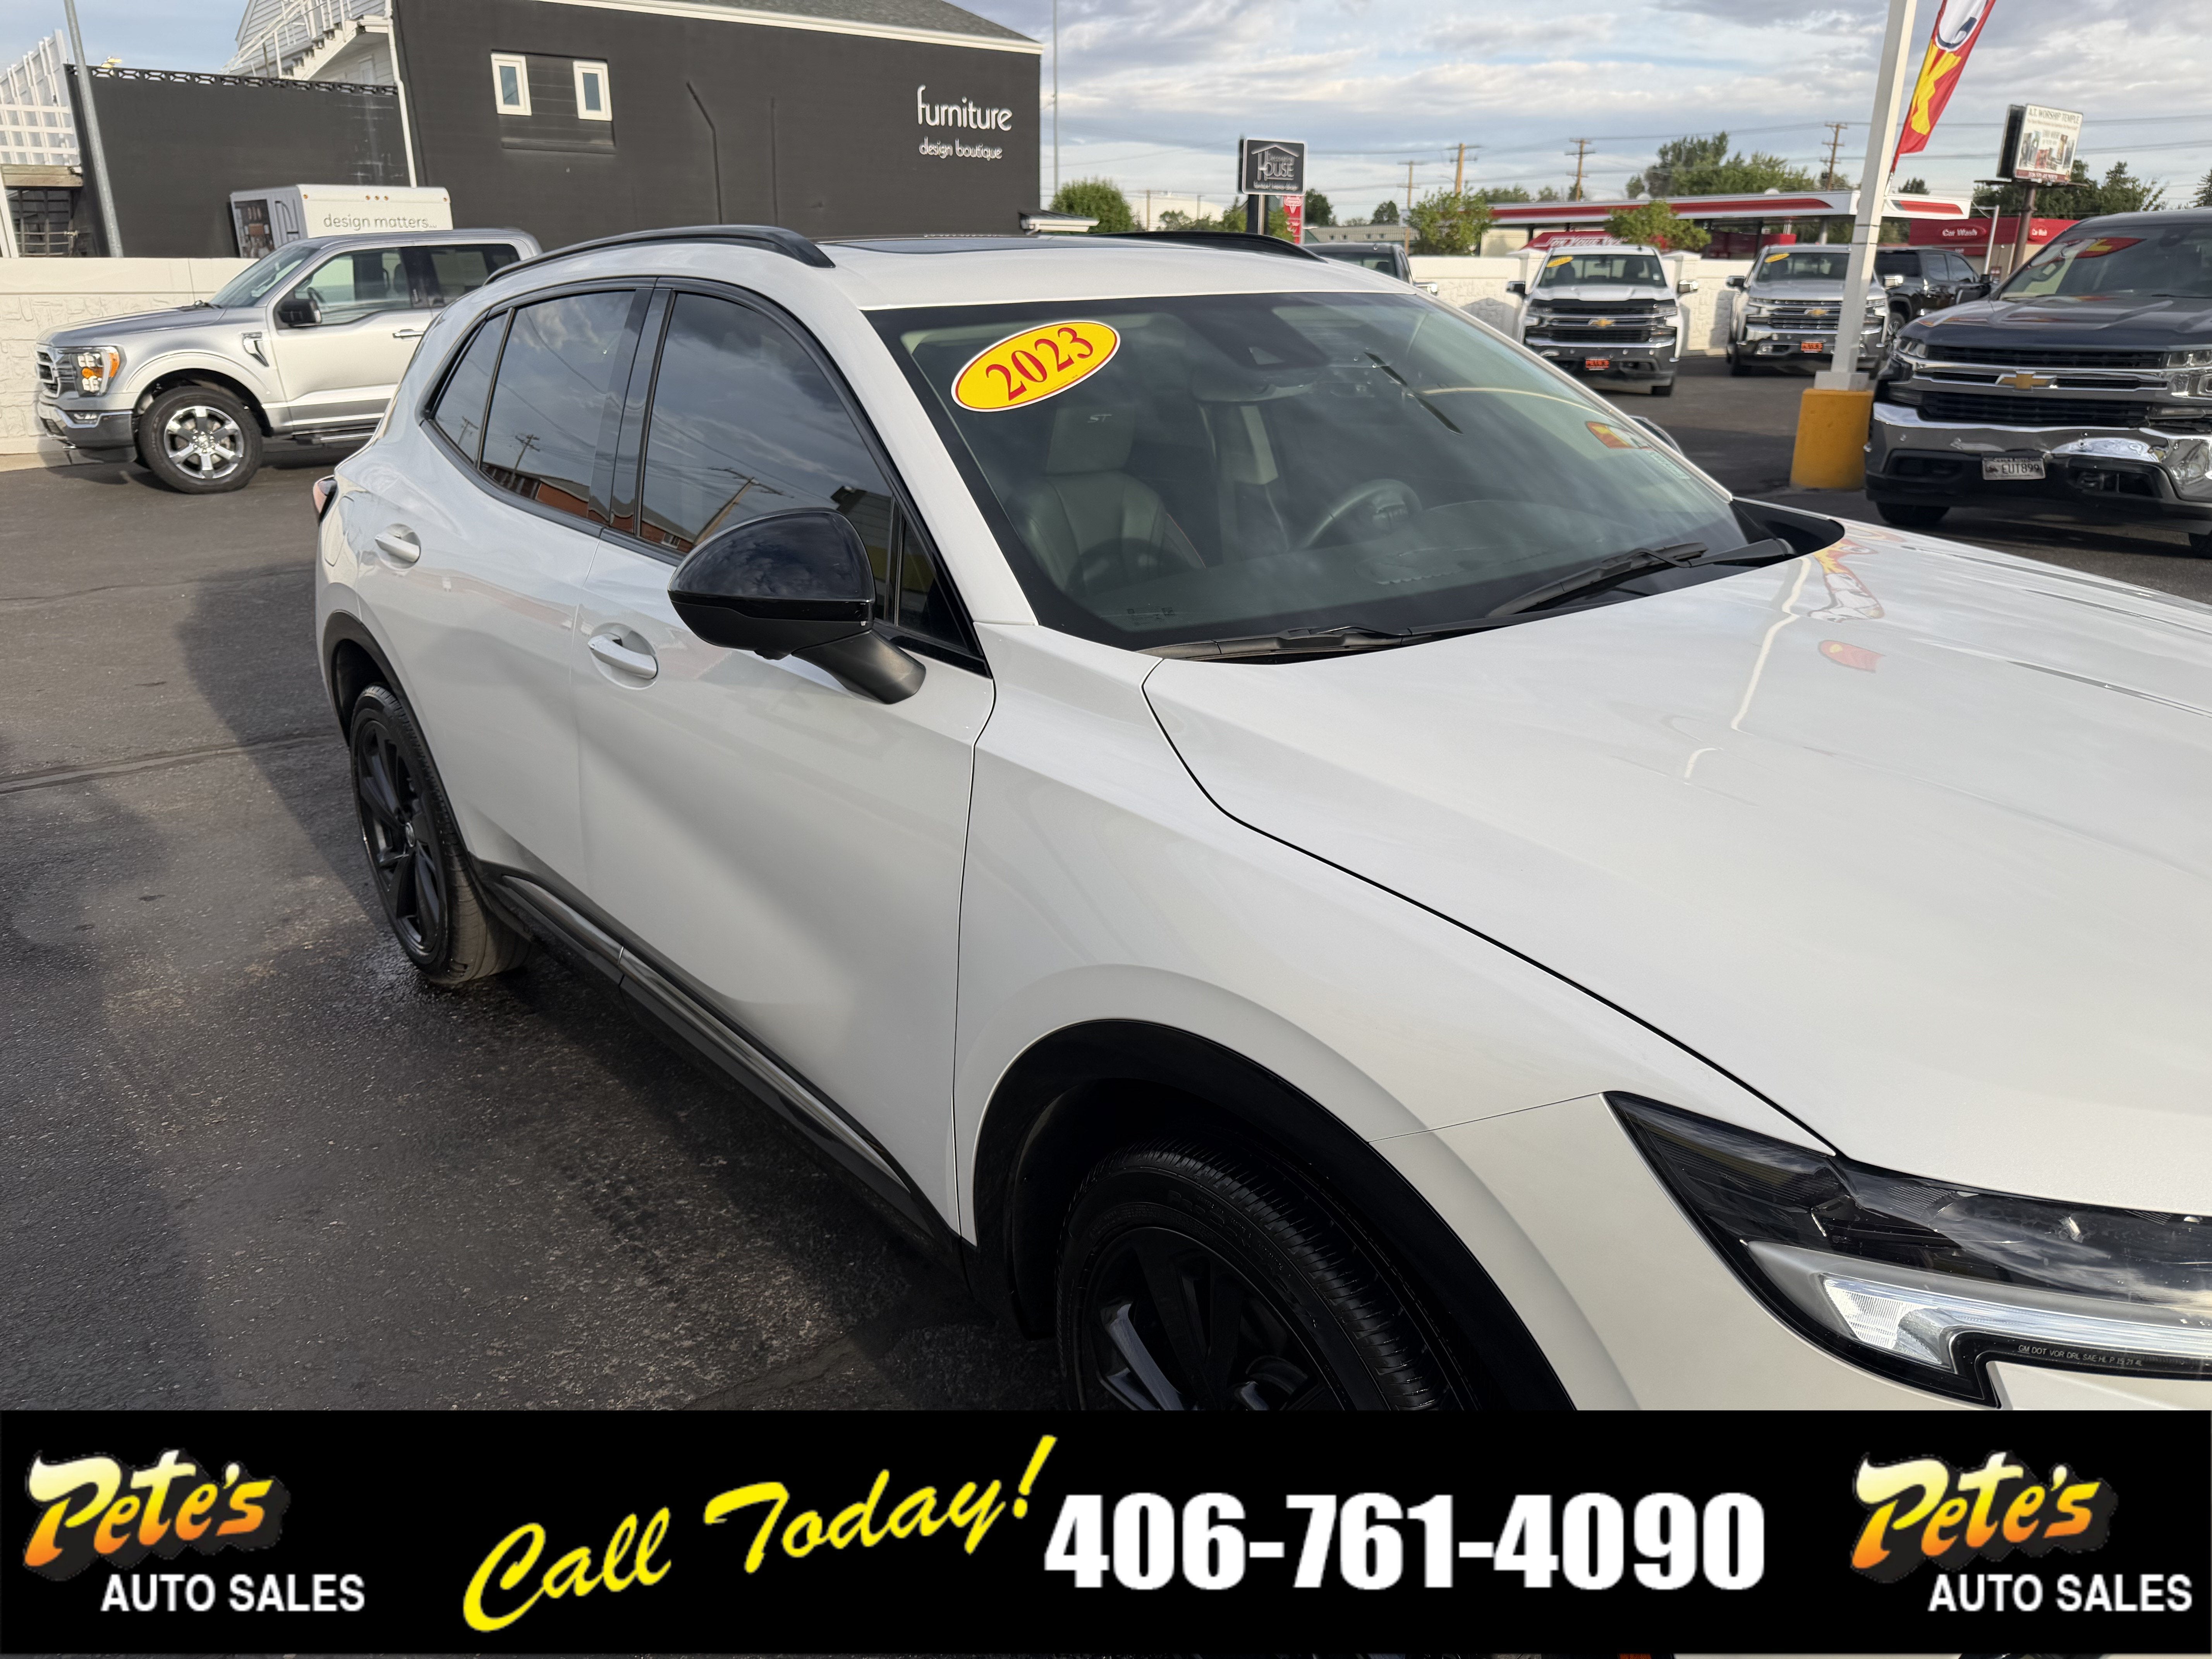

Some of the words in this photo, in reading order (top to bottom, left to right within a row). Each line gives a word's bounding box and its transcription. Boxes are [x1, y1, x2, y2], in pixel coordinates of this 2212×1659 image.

[917, 84, 1013, 131] furniture
[919, 136, 953, 159] design
[955, 137, 1003, 161] boutique
[1257, 149, 1295, 181] HOUSE
[323, 213, 371, 231] design
[1942, 228, 1956, 237] Car
[1957, 228, 1978, 237] Wash
[986, 327, 1093, 401] 2023
[2002, 464, 2039, 474] EUT899
[2018, 1344, 2030, 1354] GM
[2066, 1352, 2080, 1360] DRL
